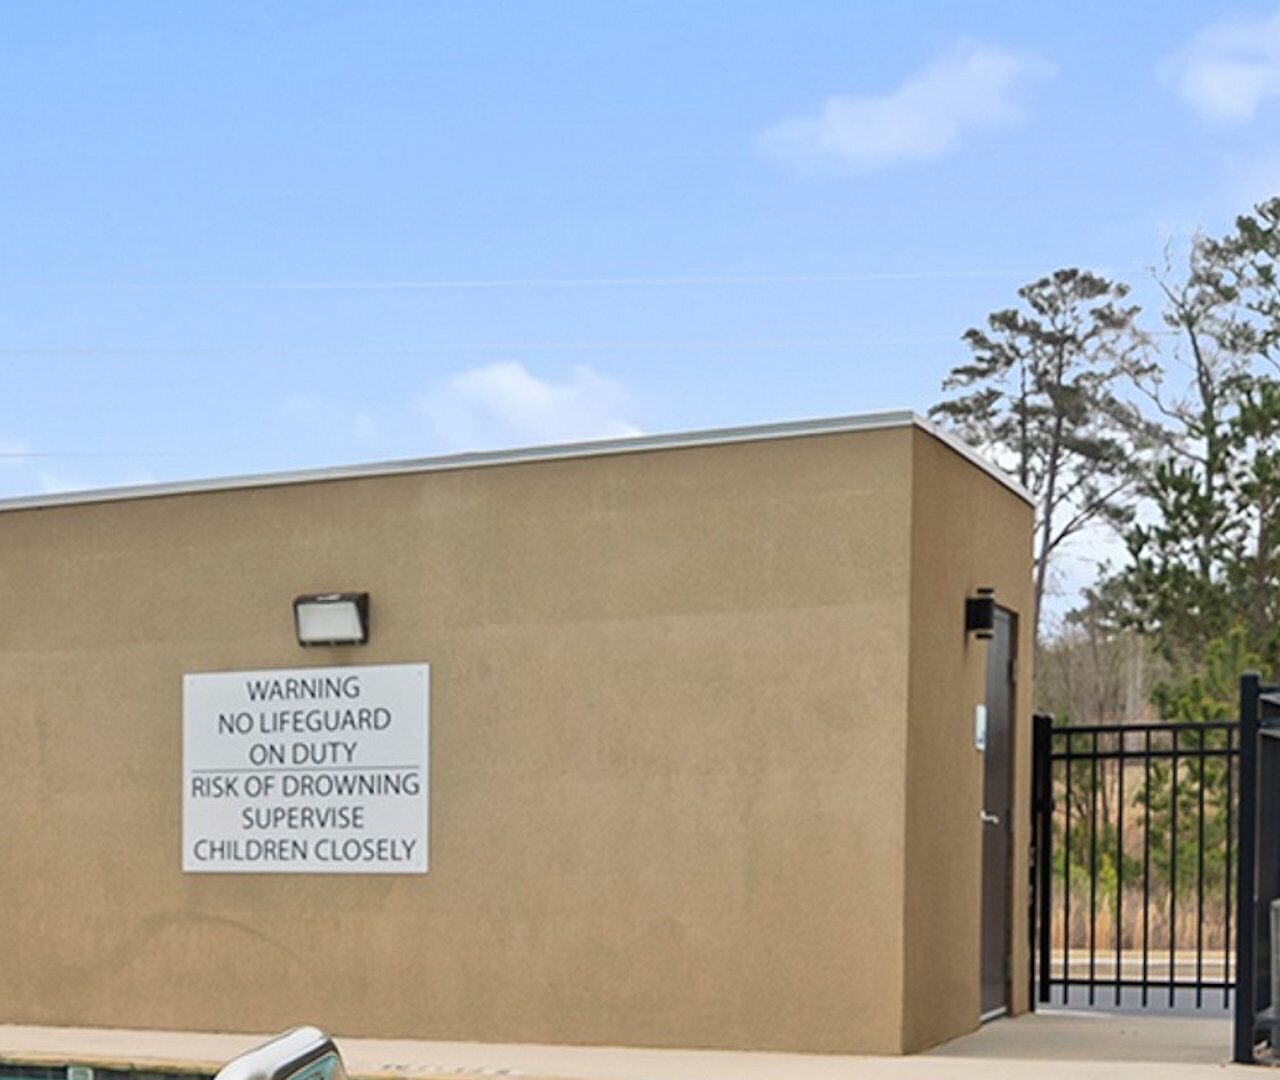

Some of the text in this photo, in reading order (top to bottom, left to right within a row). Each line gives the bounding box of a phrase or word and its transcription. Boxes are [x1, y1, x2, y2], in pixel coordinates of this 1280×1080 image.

[246, 676, 361, 701] WARNING
[218, 707, 392, 735] NO LIFEGUARD
[248, 741, 358, 766] ON DUTY
[191, 772, 421, 798] RISK OF DROWNING
[241, 806, 364, 830] SUPERVISE
[193, 838, 417, 862] CHILDREN CLOSELY
